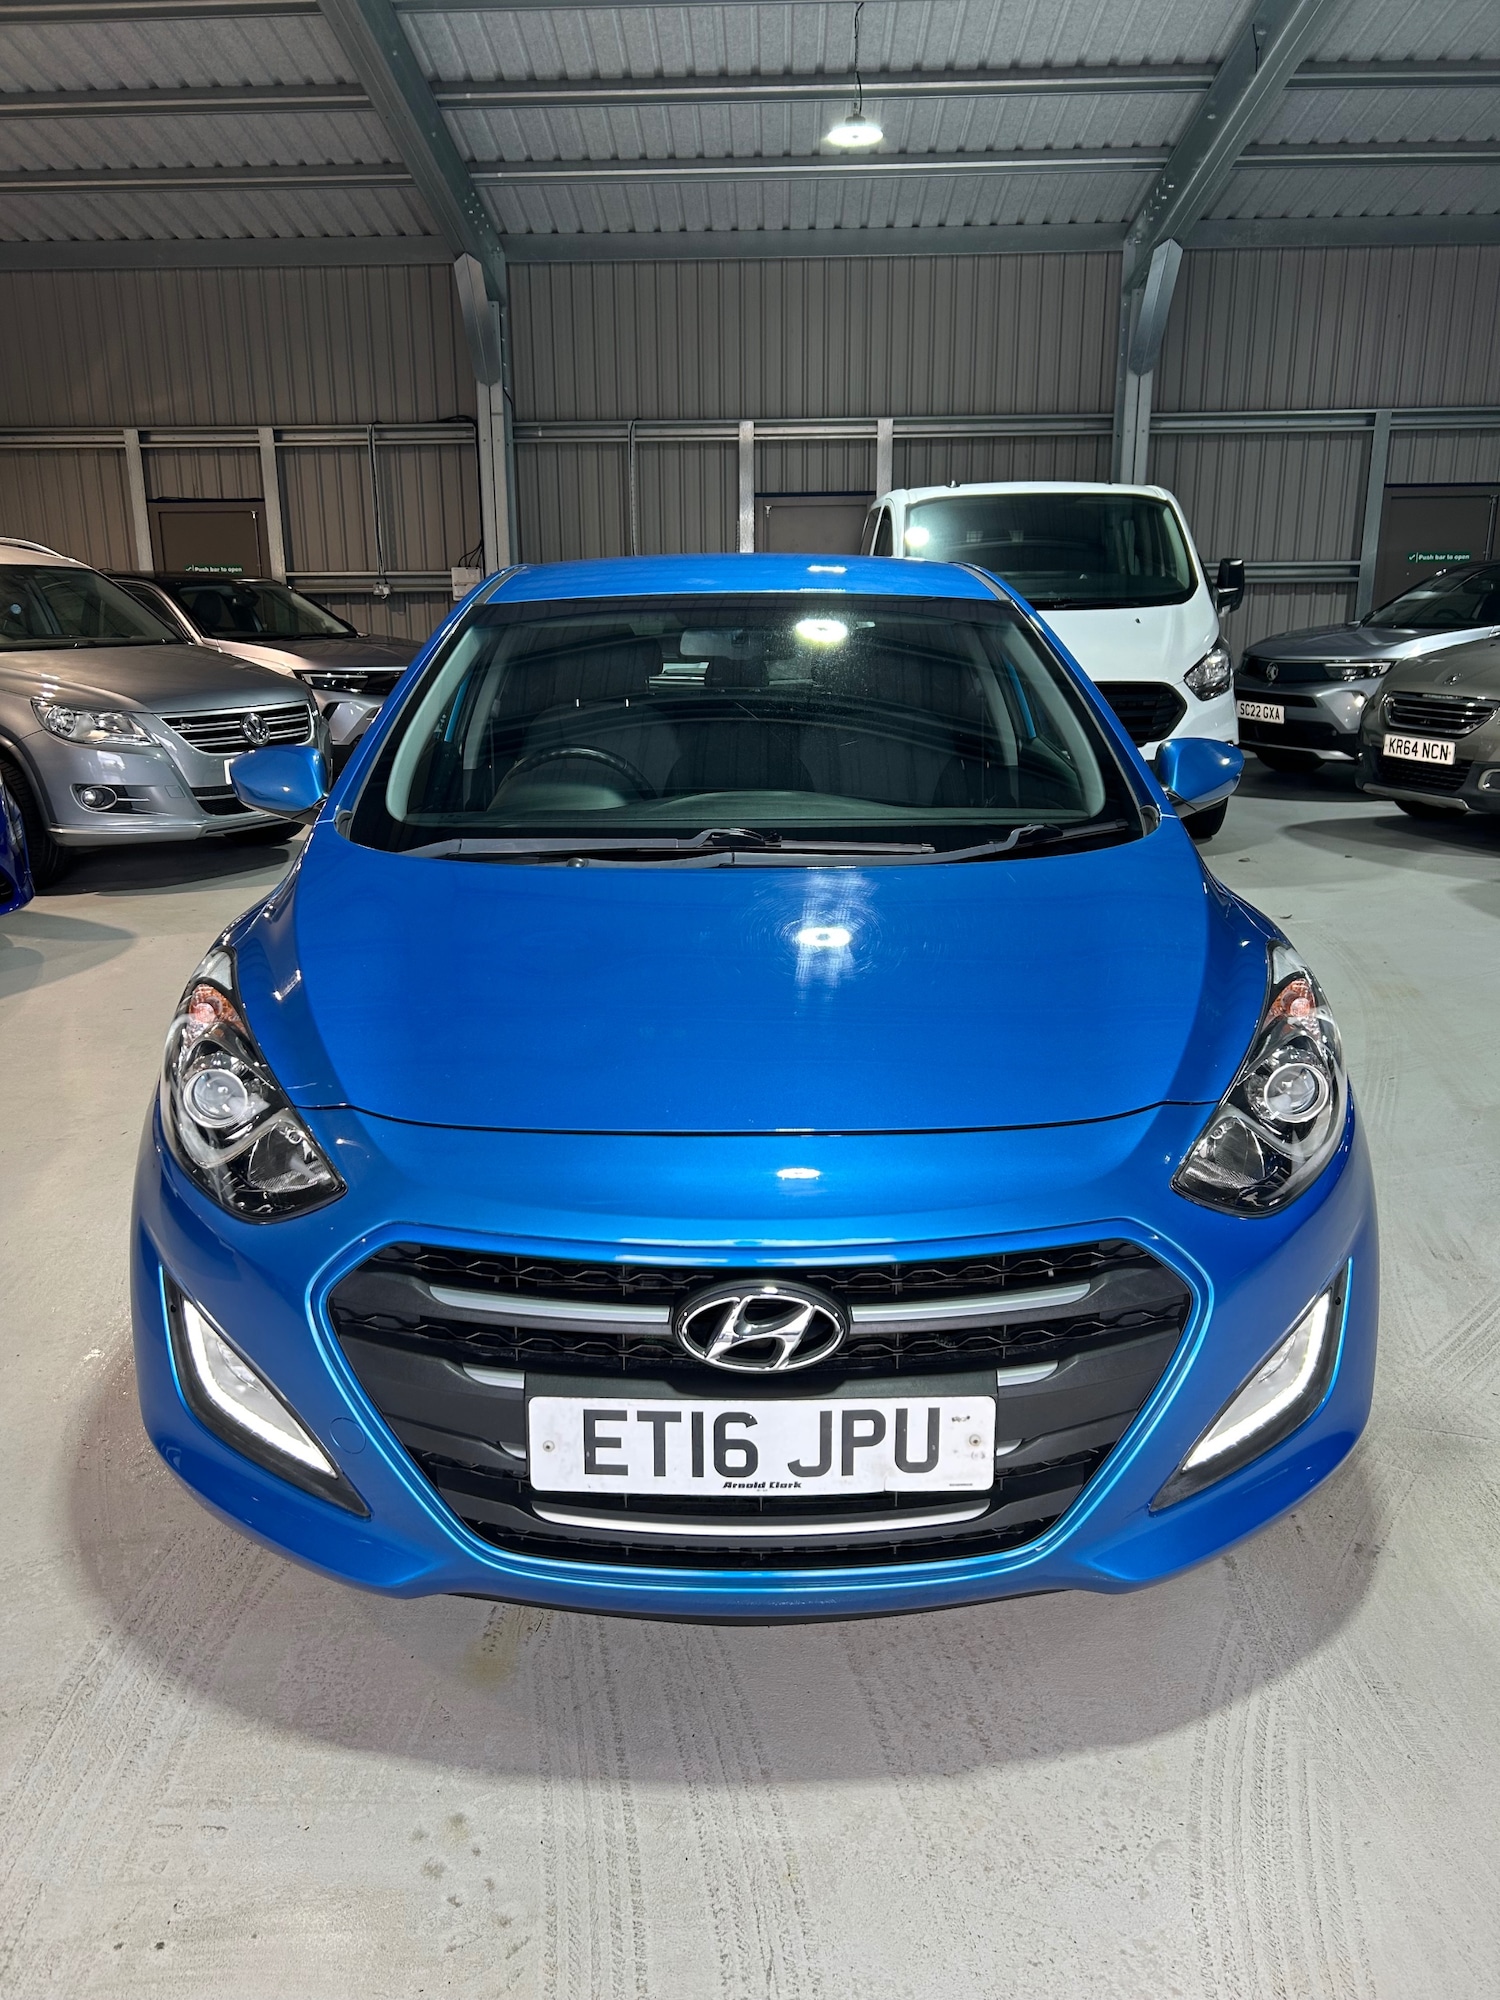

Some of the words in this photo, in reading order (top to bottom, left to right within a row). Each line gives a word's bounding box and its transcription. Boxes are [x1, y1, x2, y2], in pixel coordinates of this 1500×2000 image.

[1240, 702, 1261, 718] SC22
[1262, 706, 1281, 721] GXA
[1388, 737, 1419, 757] KR64
[1421, 742, 1449, 761] NCN
[582, 1408, 759, 1478] ET16
[787, 1407, 941, 1477] JPU
[722, 1481, 766, 1489] Arnold
[769, 1481, 802, 1489] Clark
